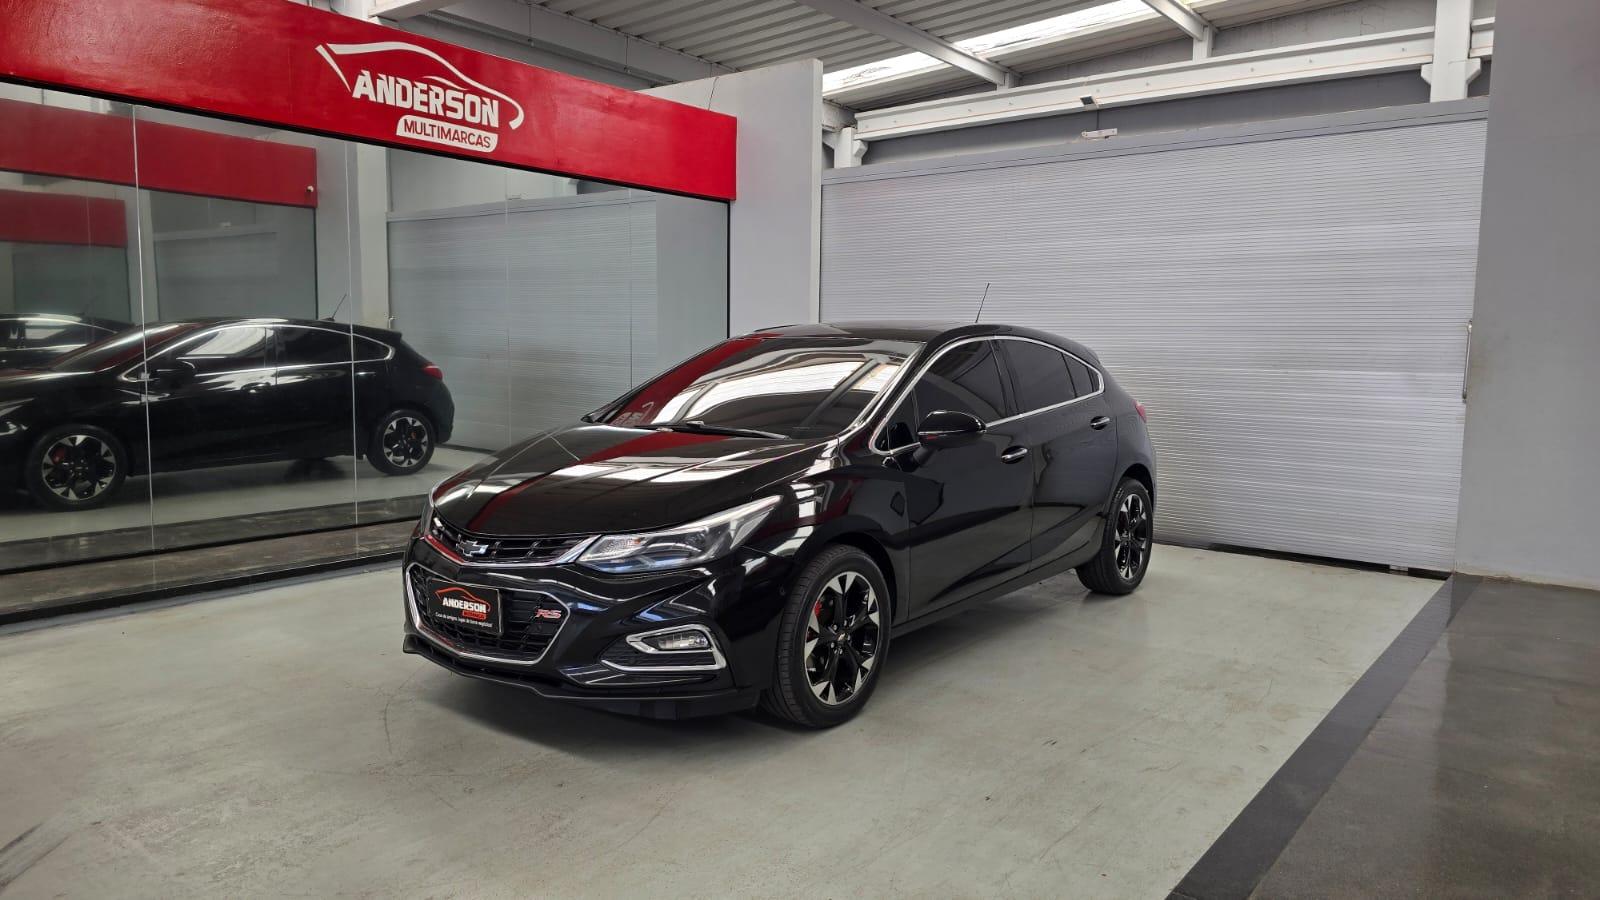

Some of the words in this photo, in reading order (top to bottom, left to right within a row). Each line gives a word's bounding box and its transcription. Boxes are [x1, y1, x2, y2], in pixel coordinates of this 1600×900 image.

[352, 69, 499, 128] ANDERSON
[403, 118, 491, 149] MULTIMARCAS
[442, 597, 487, 613] ANDERSON
[535, 609, 561, 619] RS
